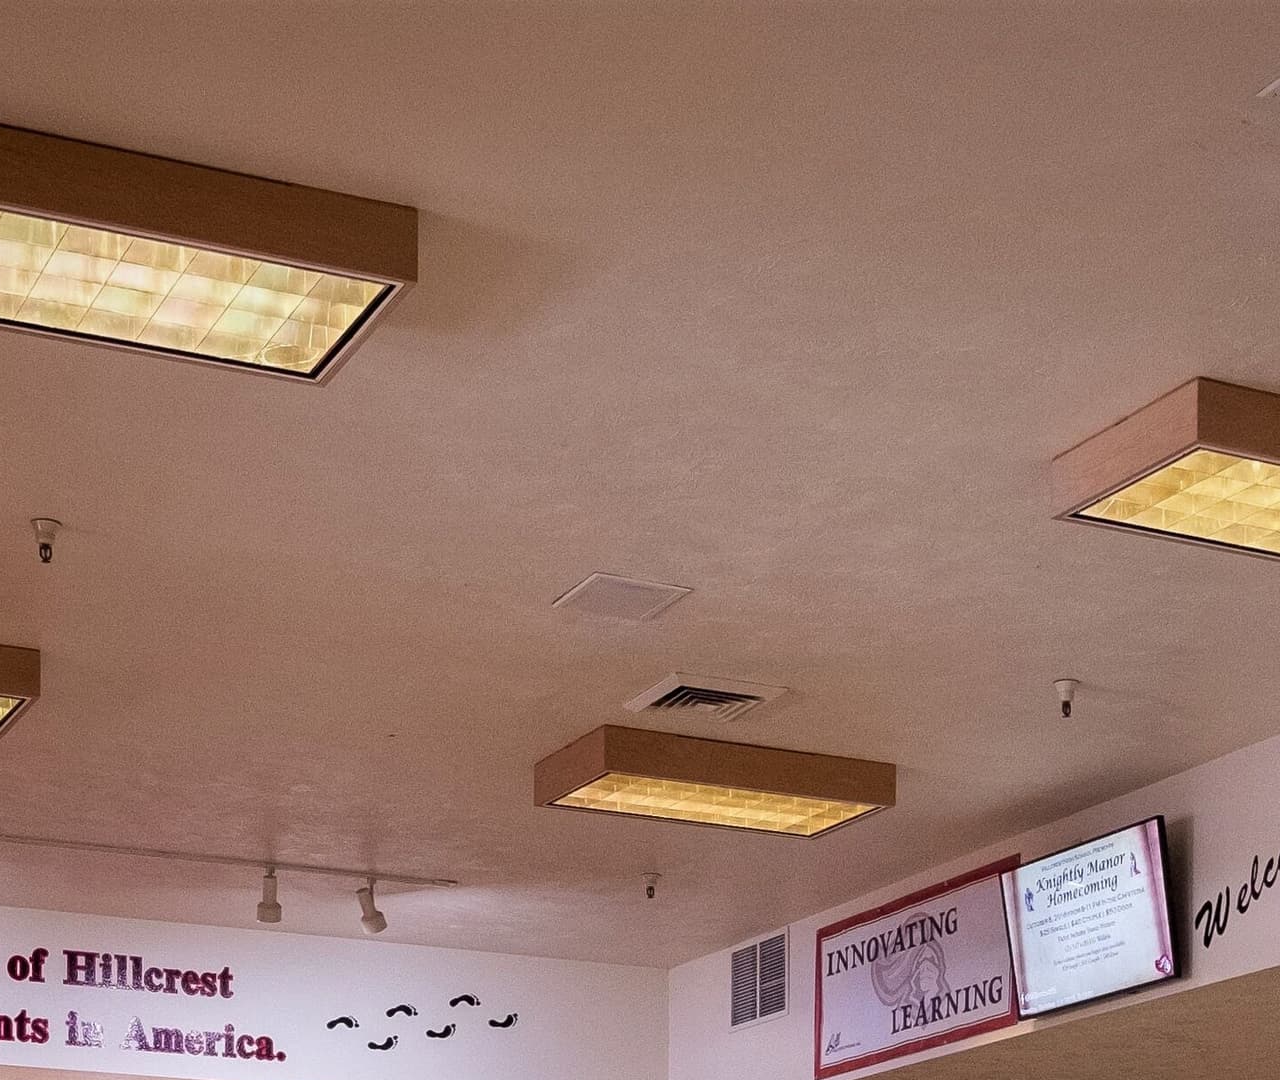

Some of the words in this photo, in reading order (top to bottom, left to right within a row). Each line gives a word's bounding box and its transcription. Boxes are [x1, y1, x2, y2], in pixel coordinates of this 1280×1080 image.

[1036, 863, 1084, 893] Knightly
[1087, 852, 1126, 876] Manor
[1047, 875, 1118, 908] Homecoming
[826, 907, 959, 977] INNOVATING
[6, 942, 49, 984] of
[63, 949, 234, 999] Hillcrest
[890, 975, 1003, 1035] LEARNING
[65, 1010, 104, 1046] in
[121, 1016, 287, 1063] America.
